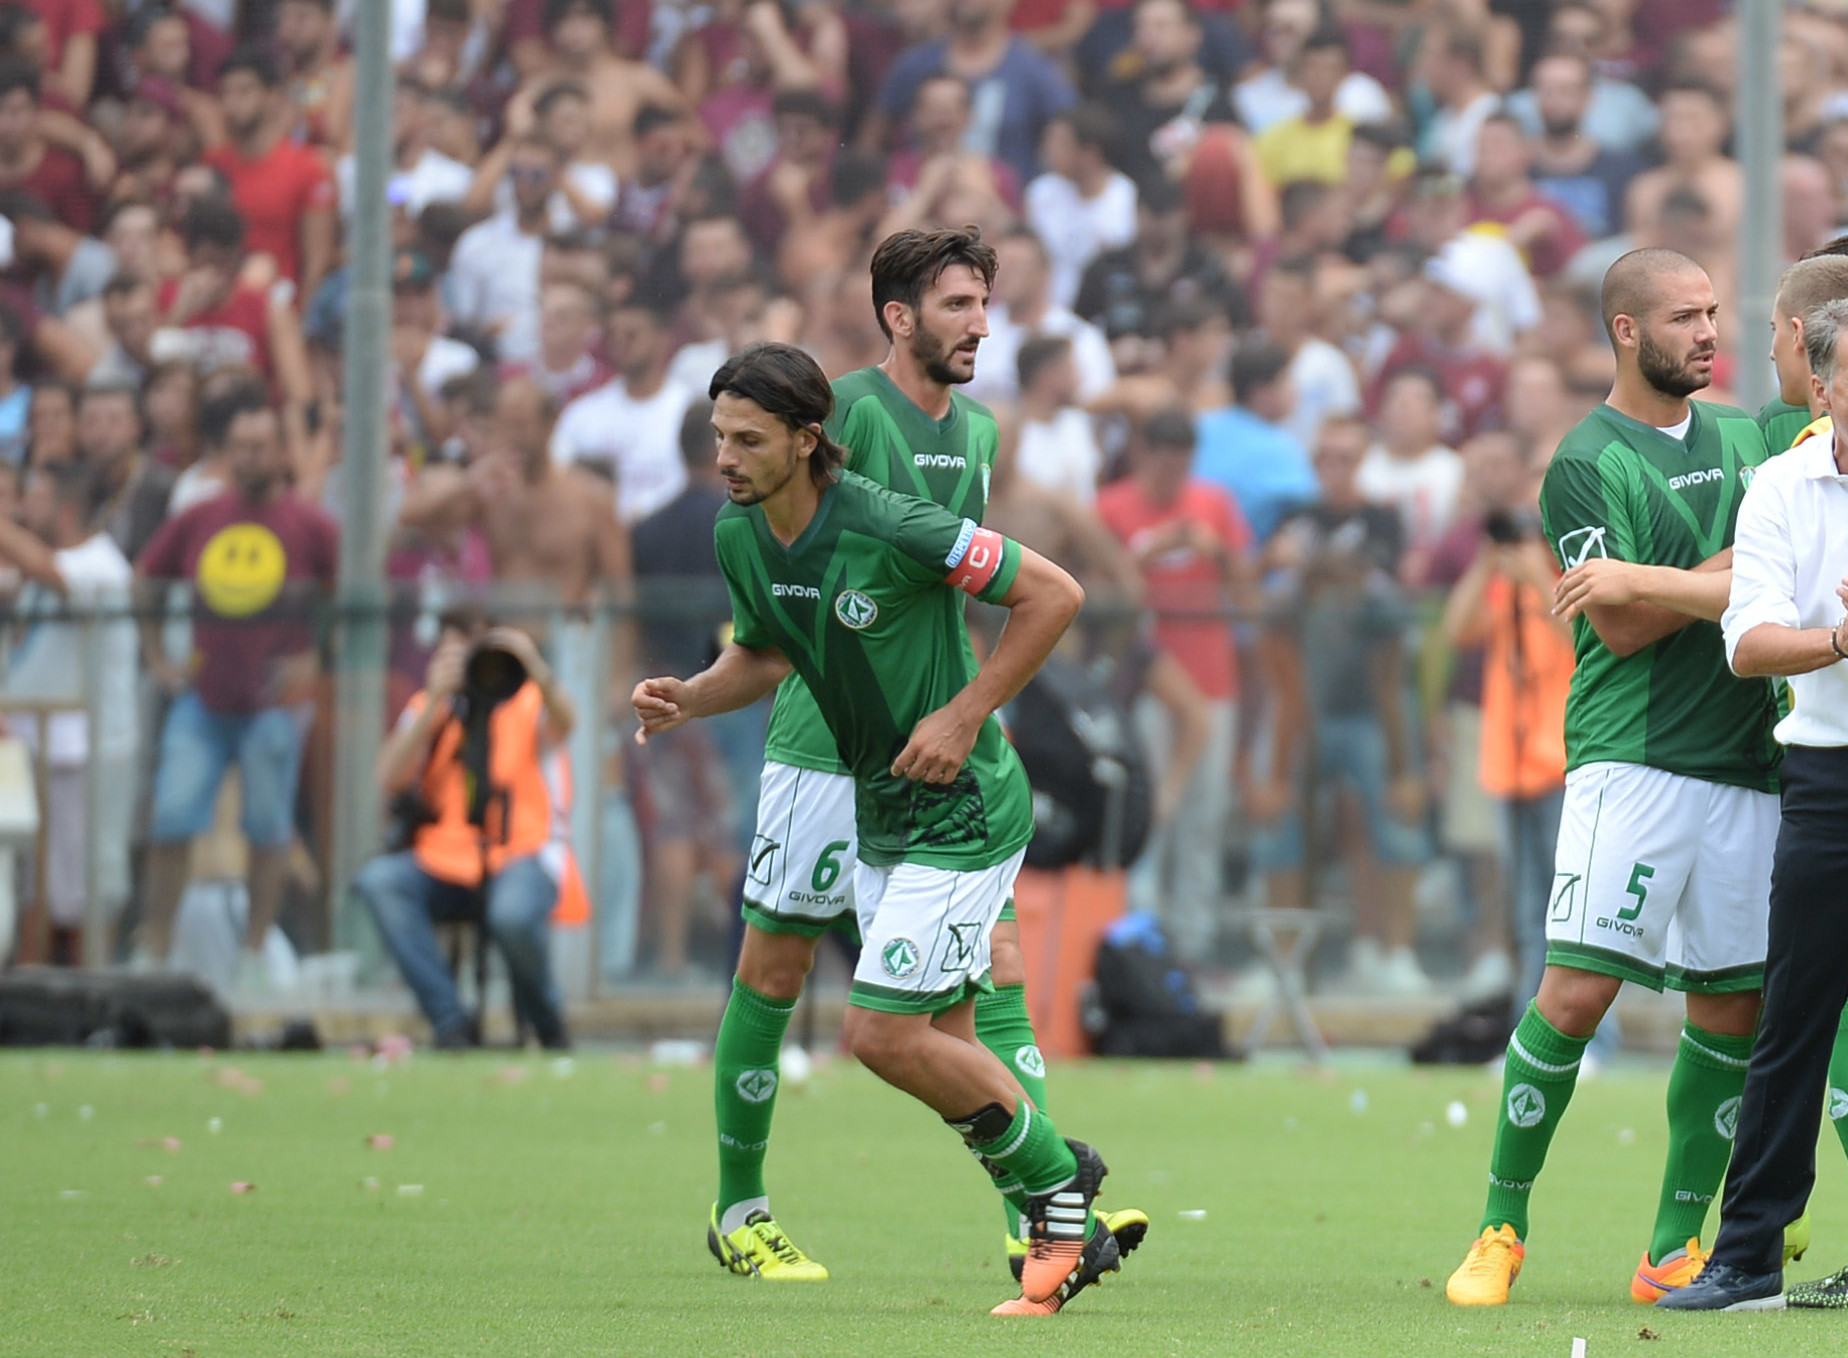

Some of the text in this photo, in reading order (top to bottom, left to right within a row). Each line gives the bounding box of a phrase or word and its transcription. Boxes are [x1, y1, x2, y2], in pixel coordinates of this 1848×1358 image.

[914, 453, 966, 469] GIVOVA
[1668, 467, 1725, 490] GIVOVA
[969, 545, 990, 569] C
[772, 583, 821, 600] GIVOVA
[811, 840, 850, 893] 6
[788, 890, 846, 906] GIVOVA
[1616, 861, 1656, 922] 5
[1595, 916, 1645, 938] GIVOVA
